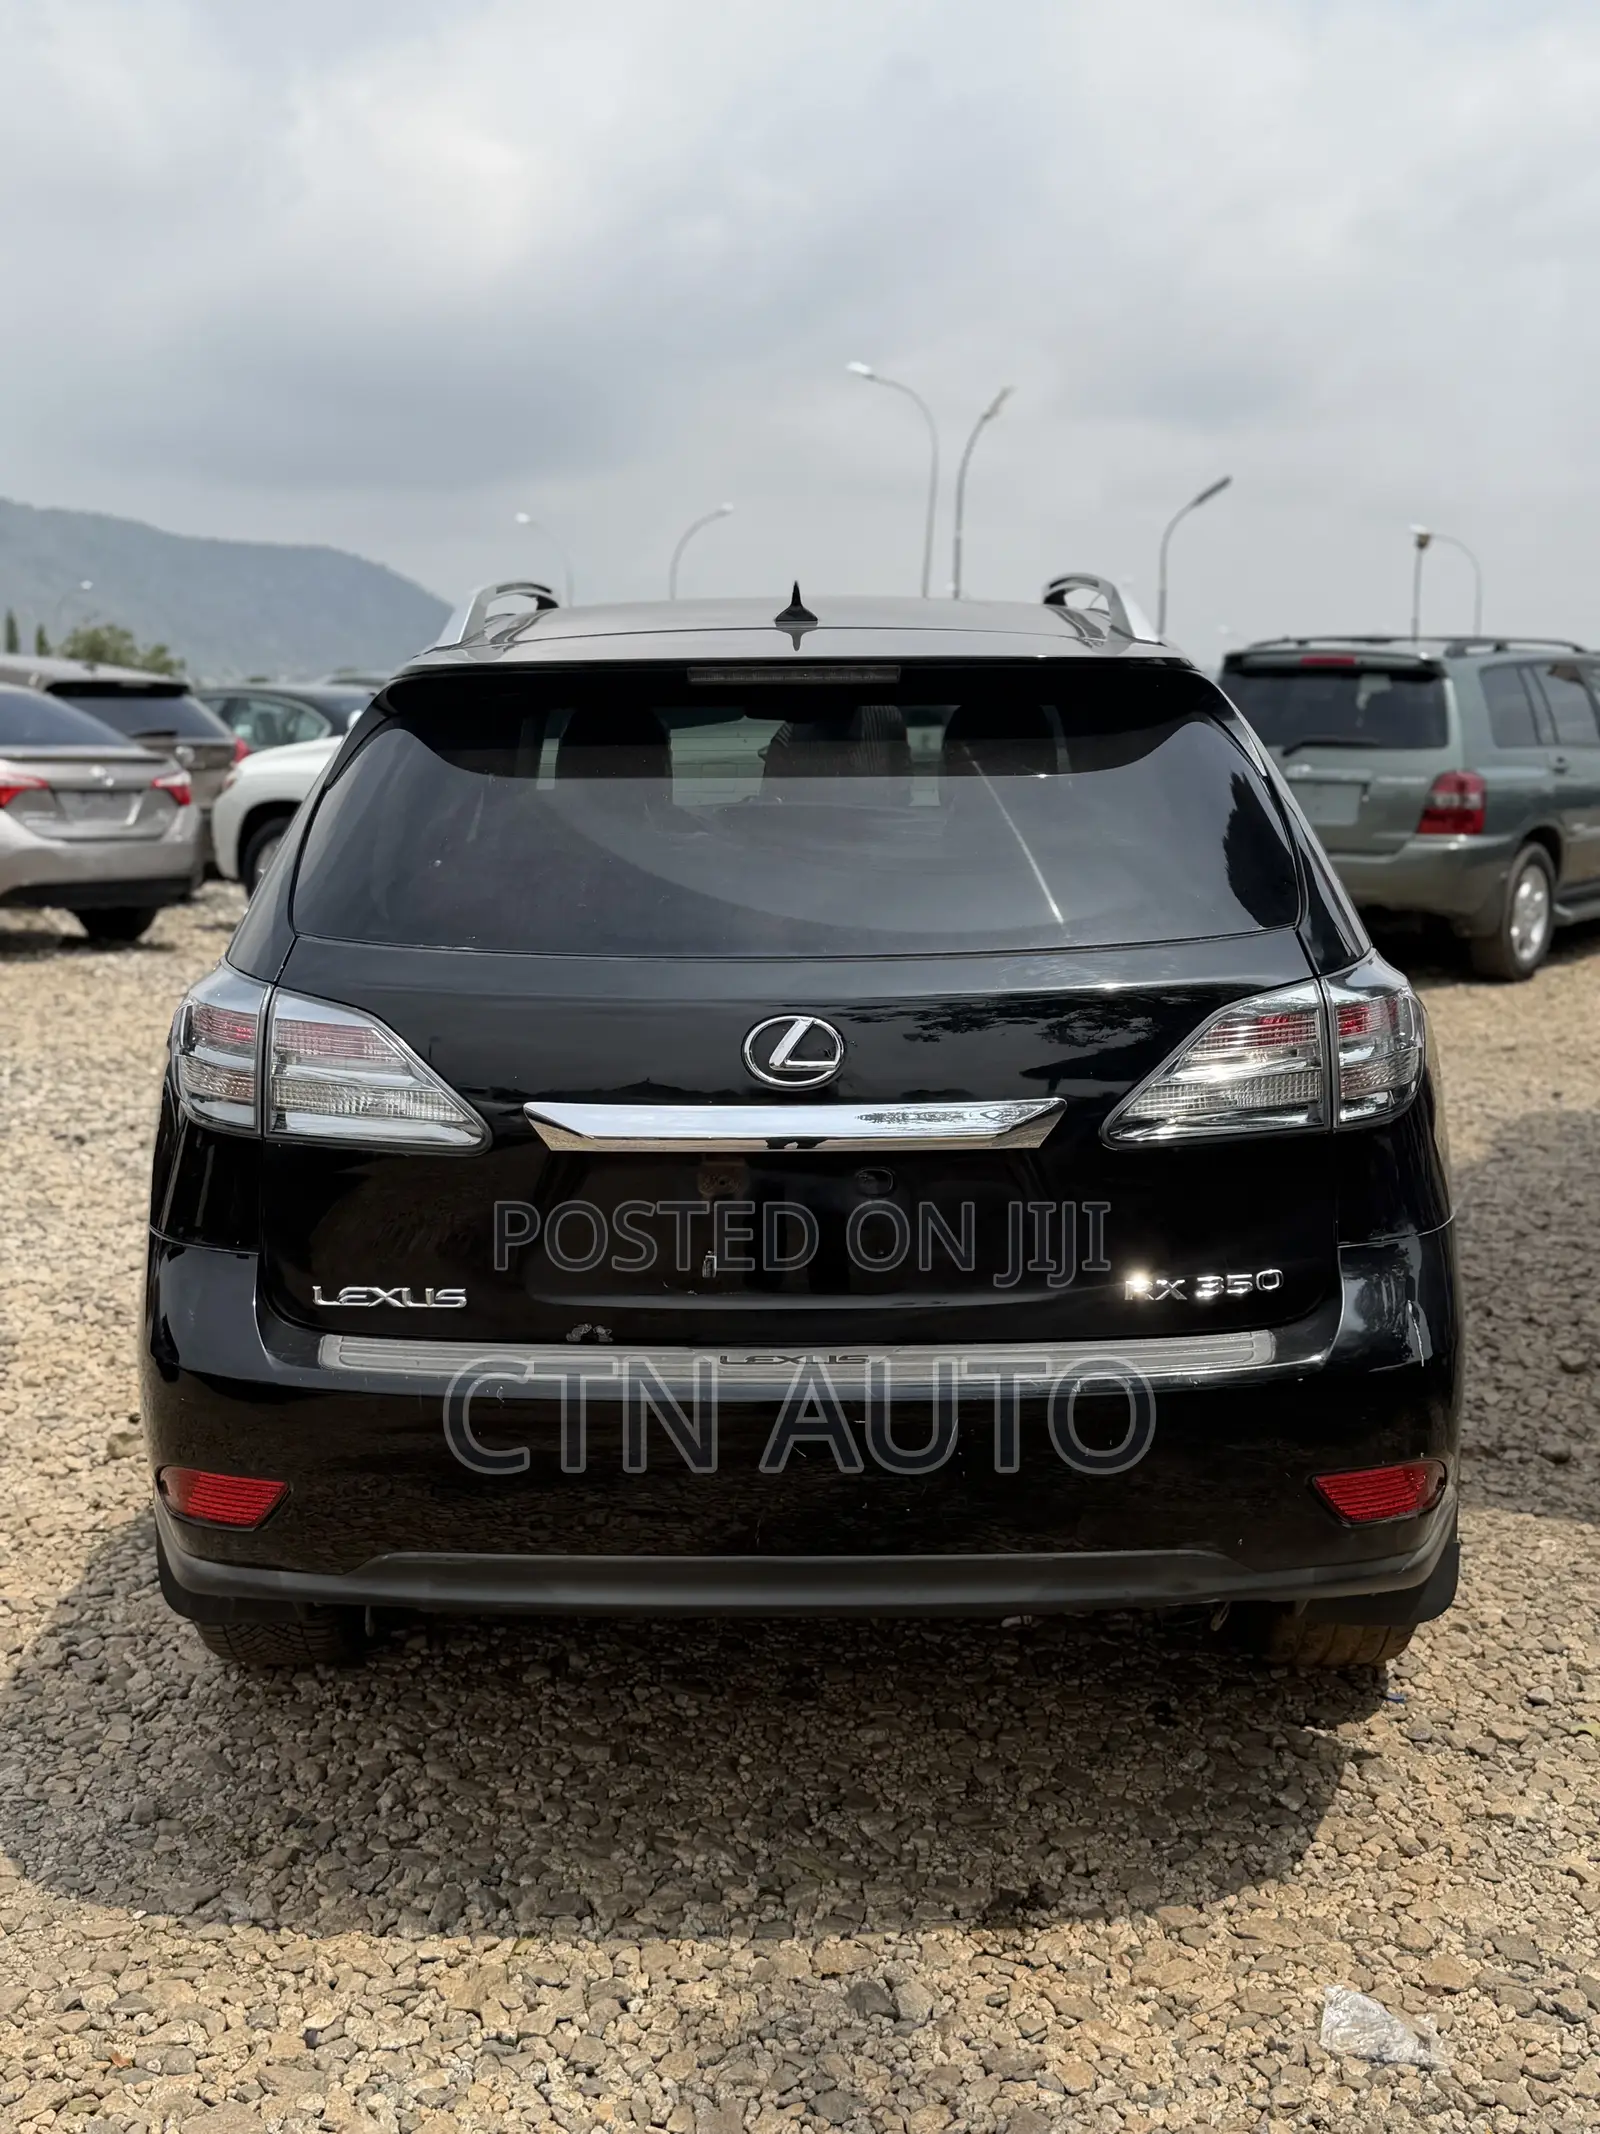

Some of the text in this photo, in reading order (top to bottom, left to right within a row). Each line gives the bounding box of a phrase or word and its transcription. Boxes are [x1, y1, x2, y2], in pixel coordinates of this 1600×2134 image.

[312, 1285, 468, 1308] LEXUS
[1124, 1269, 1284, 1301] RX 350
[719, 1354, 871, 1365] LEXUS
